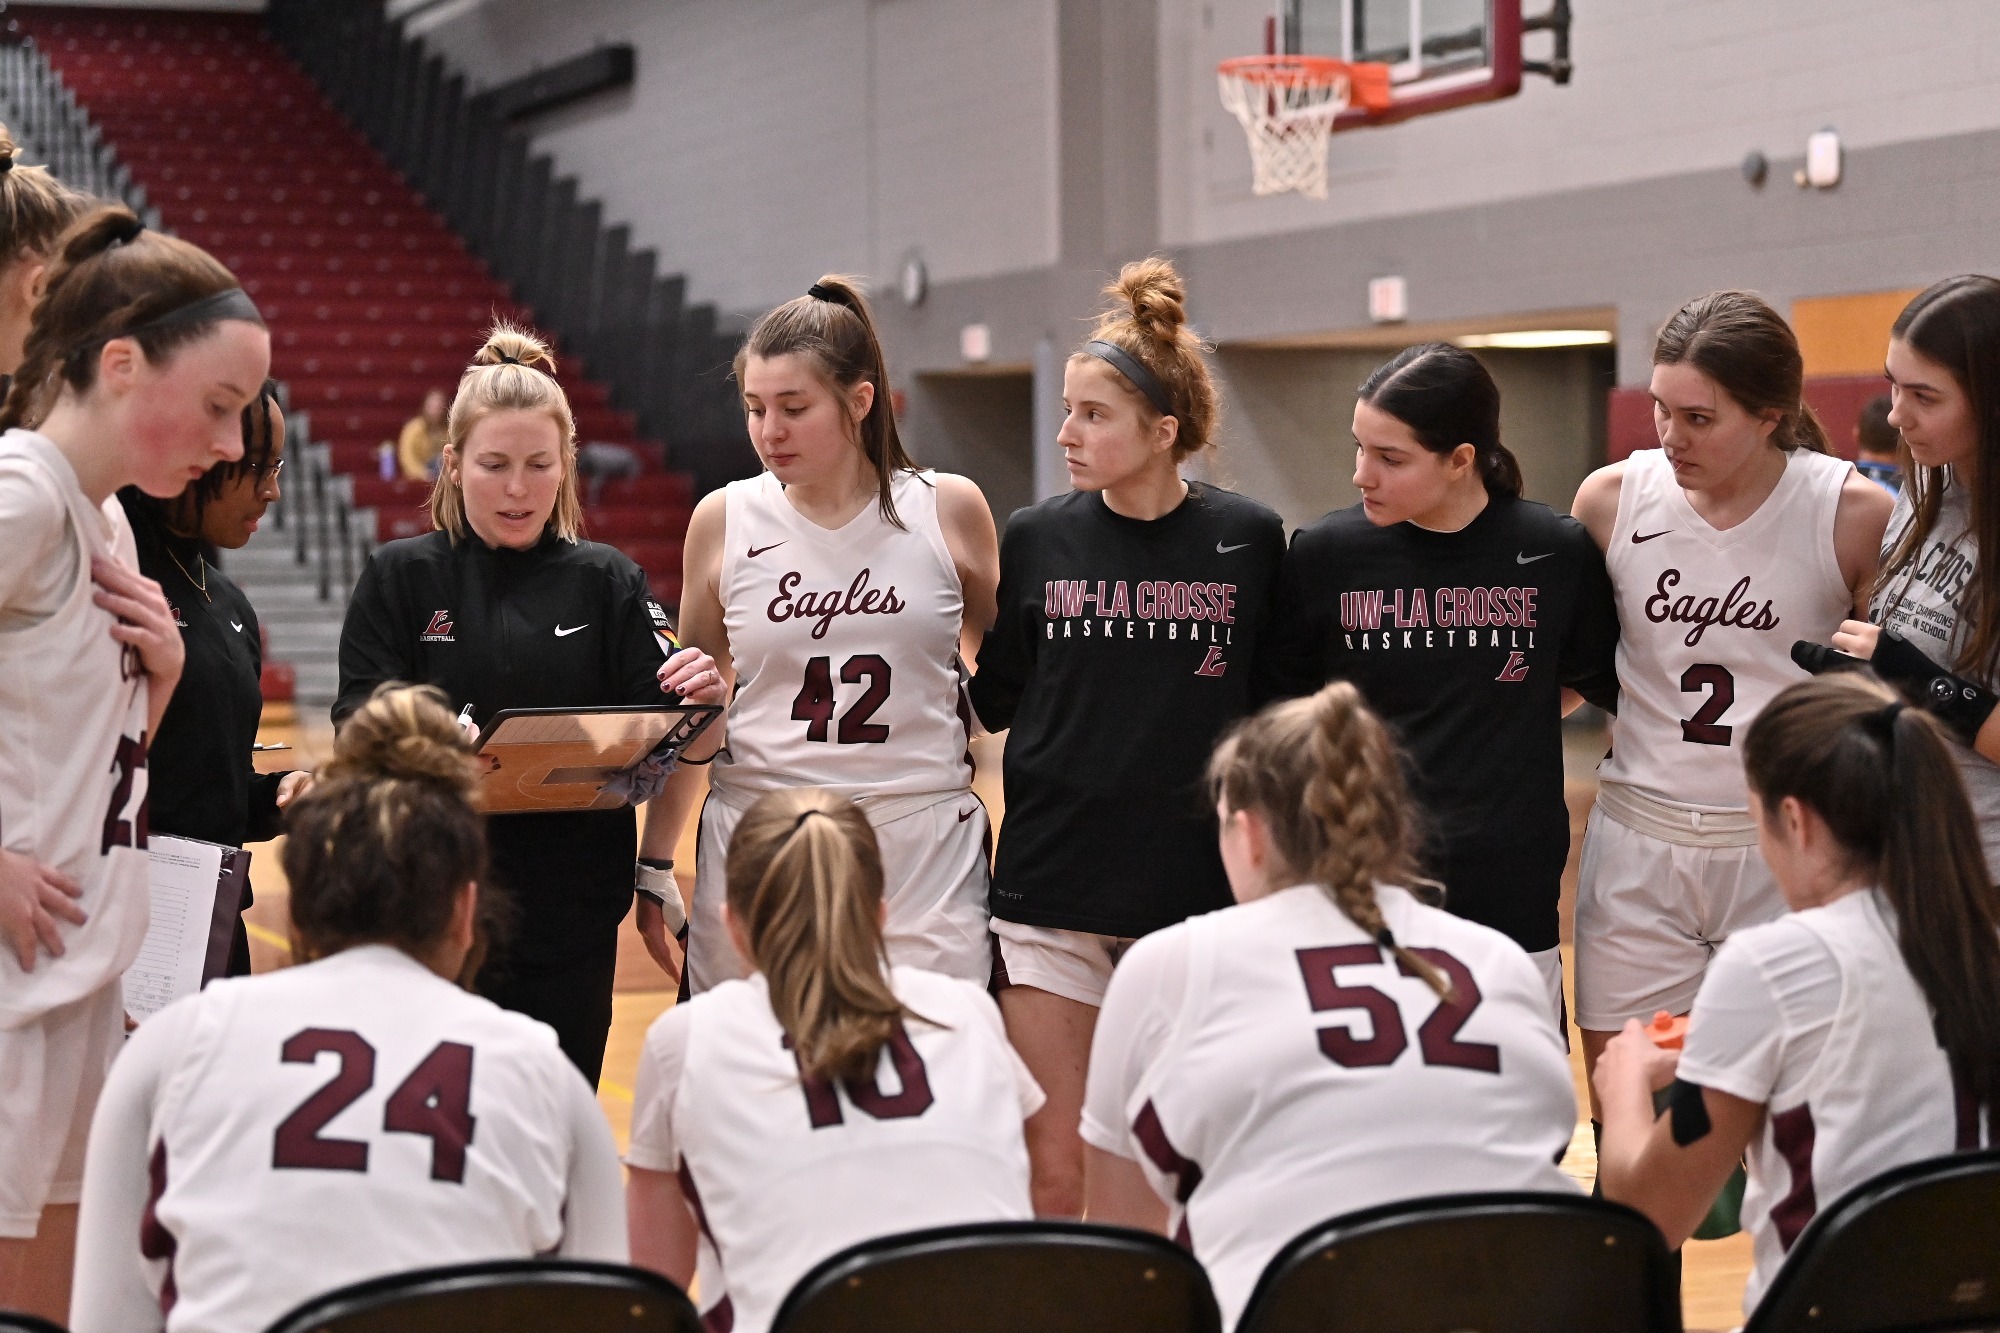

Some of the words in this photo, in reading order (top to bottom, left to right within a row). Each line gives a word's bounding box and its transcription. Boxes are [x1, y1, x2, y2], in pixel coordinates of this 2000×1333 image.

[767, 567, 906, 640] Eagles
[1045, 580, 1131, 619] UW-LA
[1137, 581, 1237, 625] CROSSE
[1340, 588, 1429, 632] UW-LA
[1435, 586, 1538, 628] CROSSE
[1645, 568, 1780, 648] Eagles
[1888, 593, 1917, 612] BUDING
[1916, 603, 1955, 629] CHAMPIONS
[1915, 541, 1977, 628] CROS
[1047, 619, 1232, 645] BASKETBALL
[1345, 629, 1535, 651] BASKETBALL
[791, 653, 892, 744] 42
[1680, 663, 1735, 747] 2
[1294, 943, 1502, 1074] 52
[271, 1026, 477, 1185] 24
